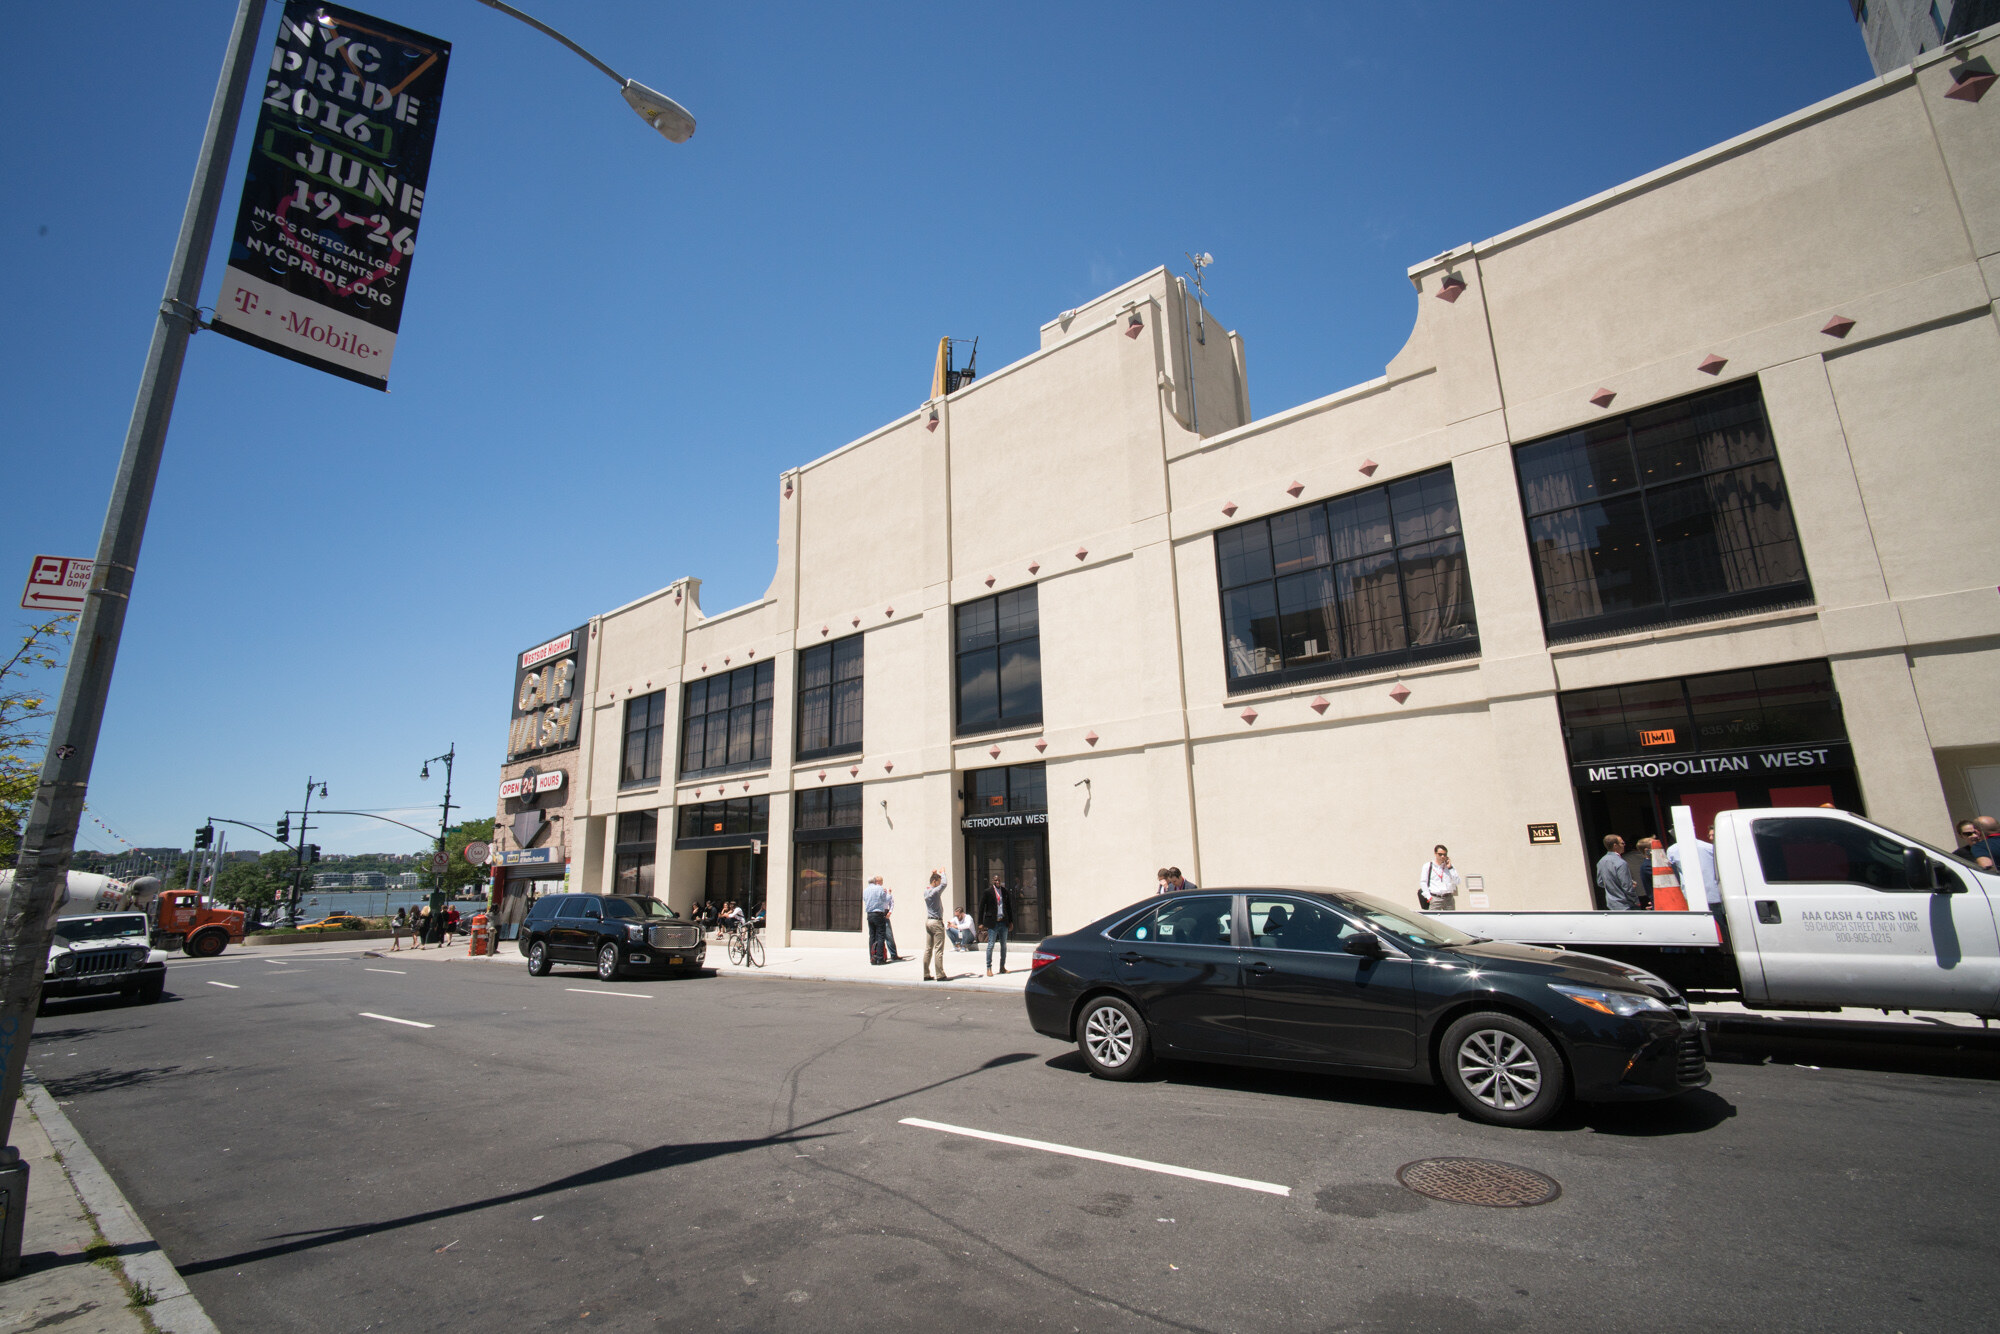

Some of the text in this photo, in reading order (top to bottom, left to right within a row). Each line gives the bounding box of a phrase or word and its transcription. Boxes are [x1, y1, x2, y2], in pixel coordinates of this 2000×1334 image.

[279, 14, 382, 73] NYC
[270, 45, 420, 126] PRIDE
[263, 79, 372, 142] 2016
[296, 143, 425, 219] JUNE
[254, 206, 400, 276] NYC'S OFFICIAL LGBT
[278, 232, 374, 281] PRIDE EVENTS
[246, 236, 392, 306] NYCPRIDE.ORG
[69, 571, 91, 580] Load
[72, 562, 94, 571] Truc
[66, 579, 87, 589] Only
[523, 637, 571, 665] WESTSIDE HIGHWAY
[519, 659, 575, 711] CAR
[508, 700, 579, 755] WASH
[1588, 749, 1829, 782] METROPOLITAN WEST
[502, 774, 560, 795] OPEN 24 HOURS
[961, 813, 1049, 829] METROPOLITAN WEST
[1801, 911, 1918, 921] AAA CASH 4 CARS INC
[1804, 922, 1815, 932] 59
[1816, 922, 1848, 932] CHURCH
[1879, 922, 1896, 932] NEW
[1899, 922, 1920, 932] YORK
[1835, 932, 1893, 943] 800-905-0215
